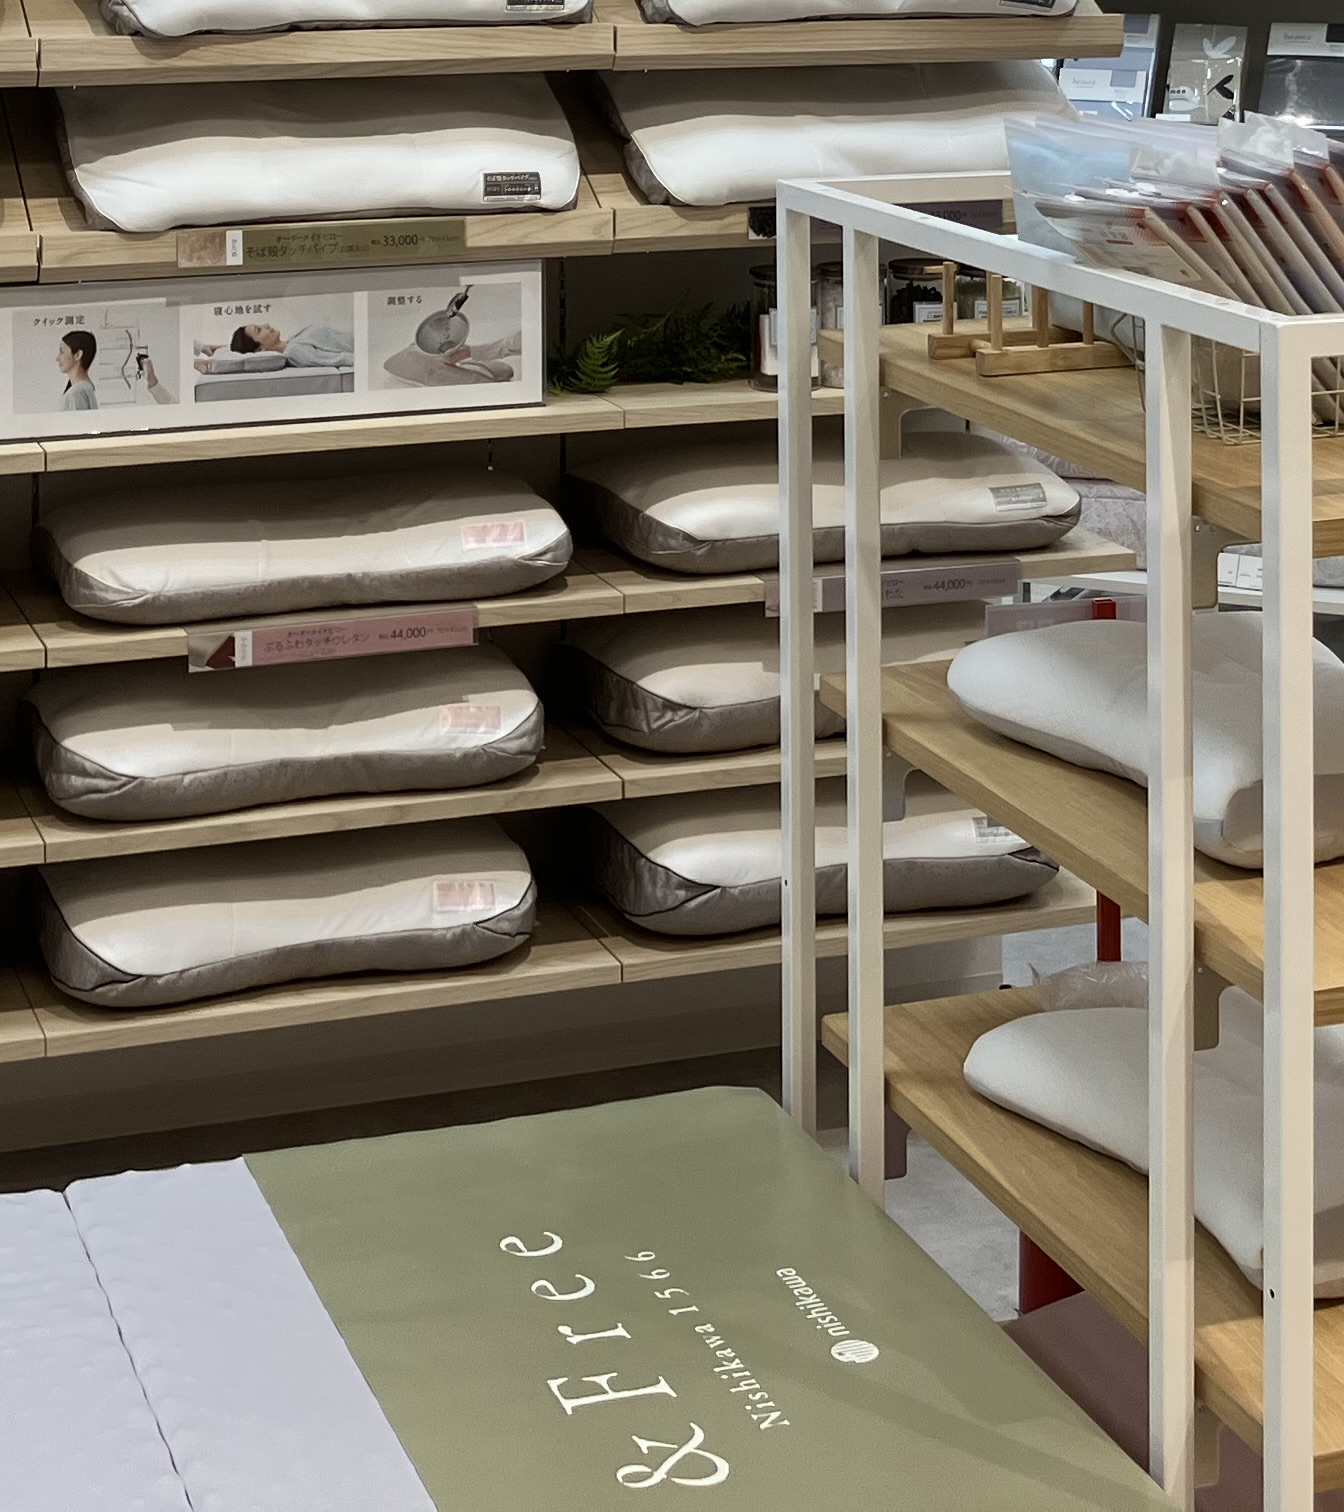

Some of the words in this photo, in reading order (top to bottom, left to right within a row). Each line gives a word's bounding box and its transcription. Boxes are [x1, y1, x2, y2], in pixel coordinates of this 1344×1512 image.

[386, 295, 423, 306] 調整する
[624, 1249, 700, 1316] 1566
[775, 1267, 851, 1337] nishikawa
[693, 1323, 791, 1432] Nishikawa
